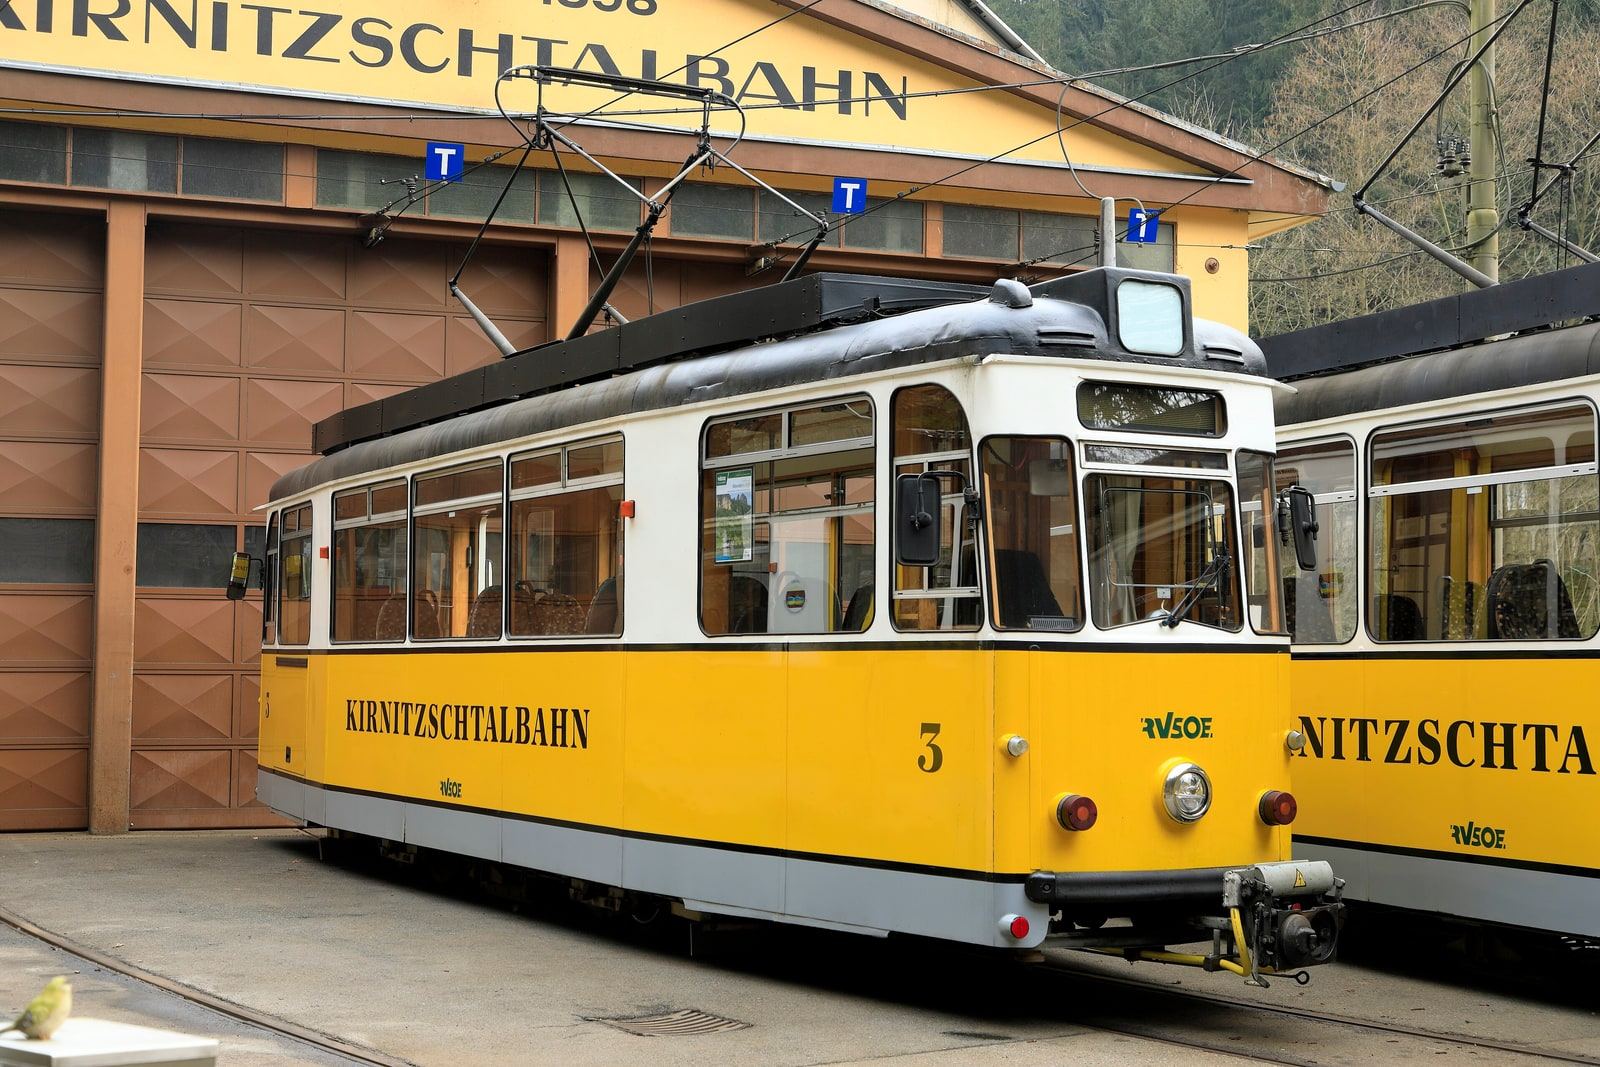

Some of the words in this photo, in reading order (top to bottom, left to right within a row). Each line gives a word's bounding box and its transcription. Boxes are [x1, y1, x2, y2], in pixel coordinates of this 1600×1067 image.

[434, 147, 457, 176] T
[840, 182, 861, 209] T
[345, 699, 591, 750] KIRNITZSCHTALBAHN
[917, 722, 944, 773] 3
[1291, 715, 1597, 776] NITZSCHTA
